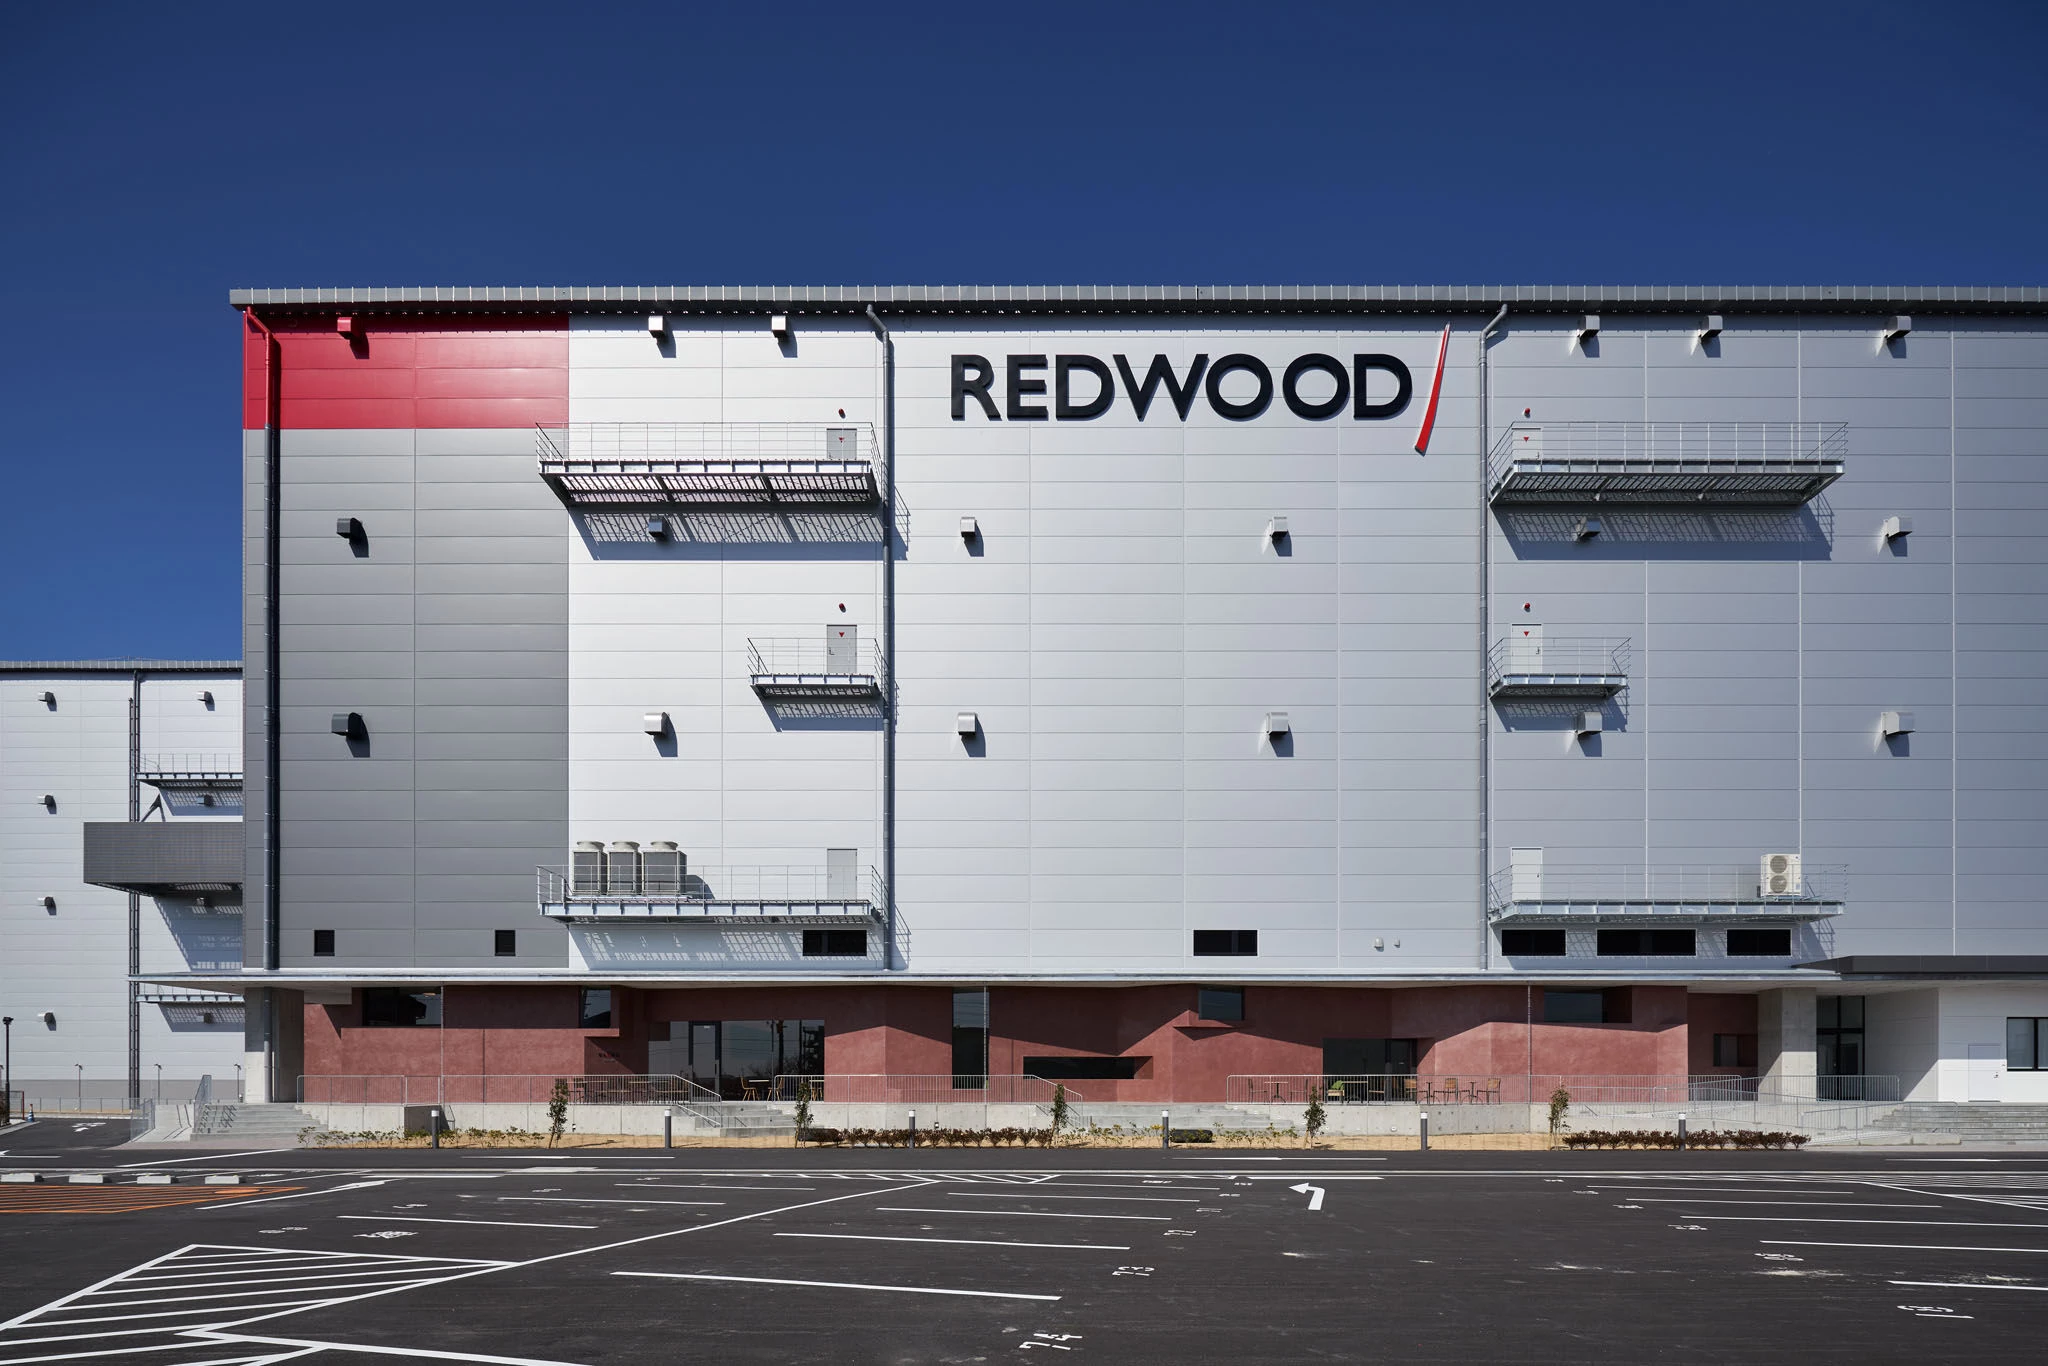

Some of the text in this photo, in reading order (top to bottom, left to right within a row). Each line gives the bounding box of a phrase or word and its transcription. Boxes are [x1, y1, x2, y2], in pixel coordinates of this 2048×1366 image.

[950, 353, 1413, 421] REDWOOD
[1112, 1266, 1155, 1277] 73
[1019, 1333, 1083, 1351] 74
